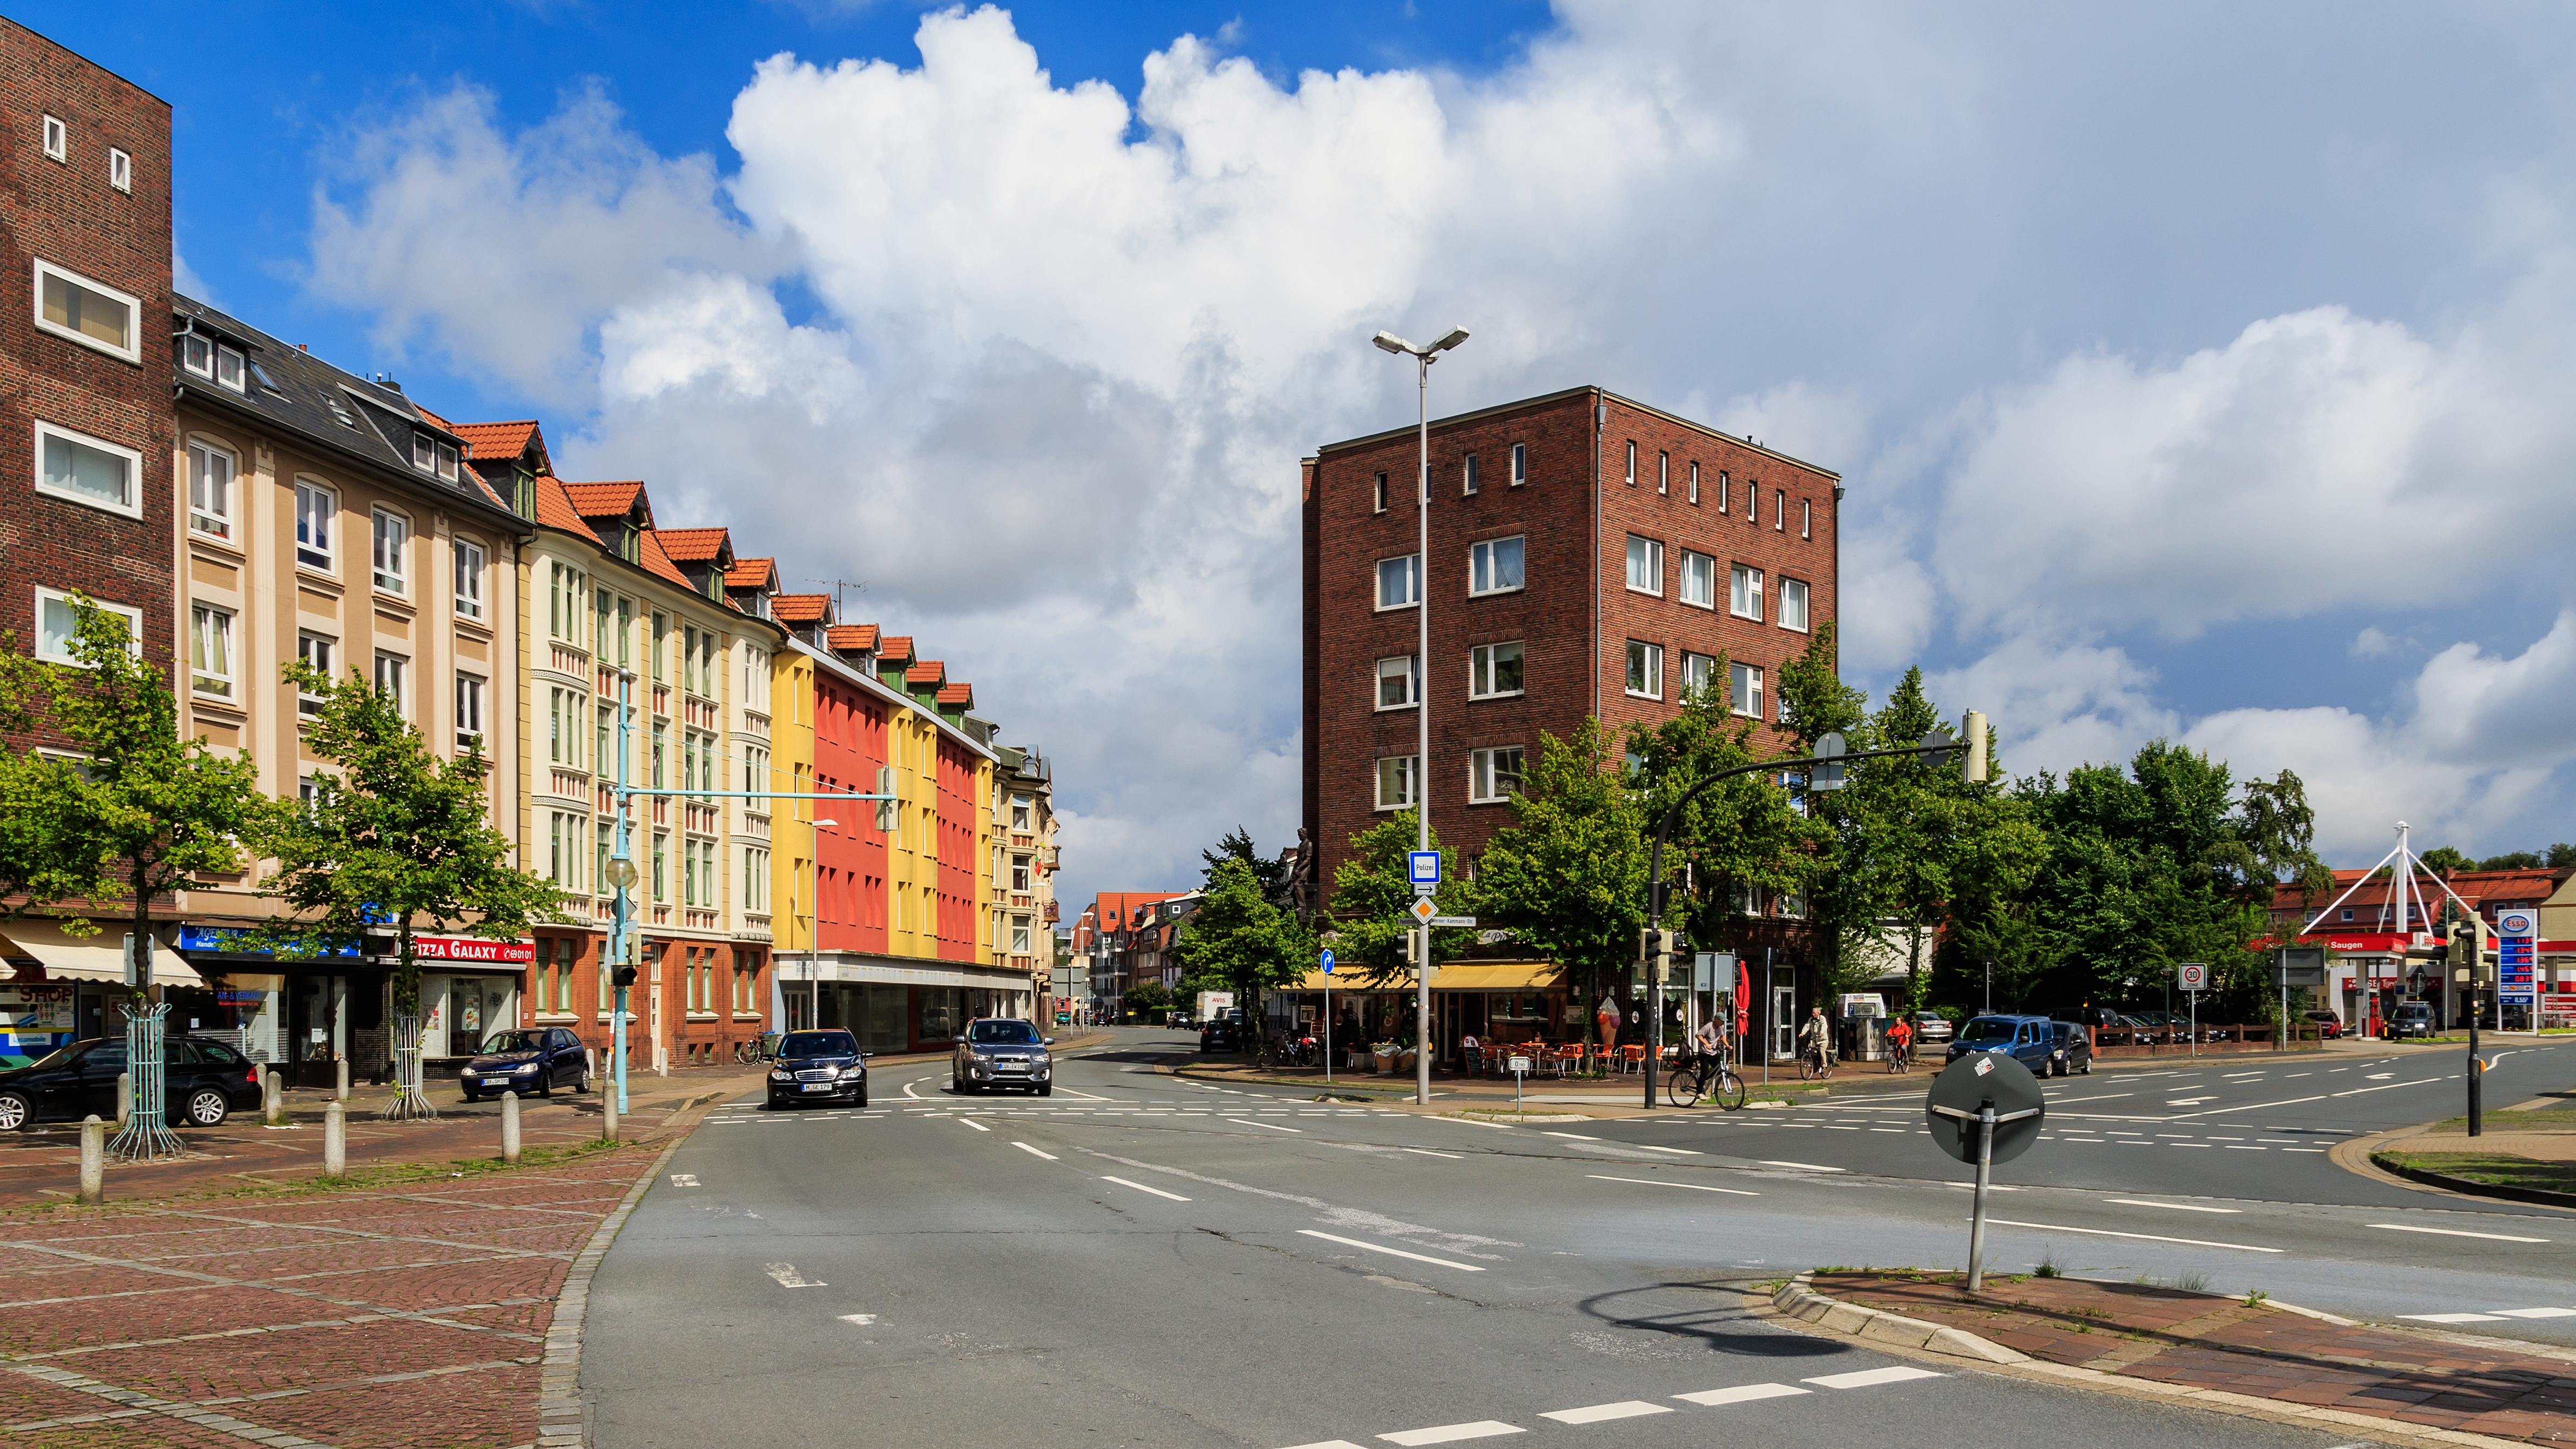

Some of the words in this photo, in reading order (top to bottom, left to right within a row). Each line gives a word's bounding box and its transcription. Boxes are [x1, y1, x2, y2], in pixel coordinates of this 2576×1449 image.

[451, 940, 497, 959] GALAXY
[2330, 941, 2363, 950] Saugen
[235, 991, 261, 999] VERKAUF
